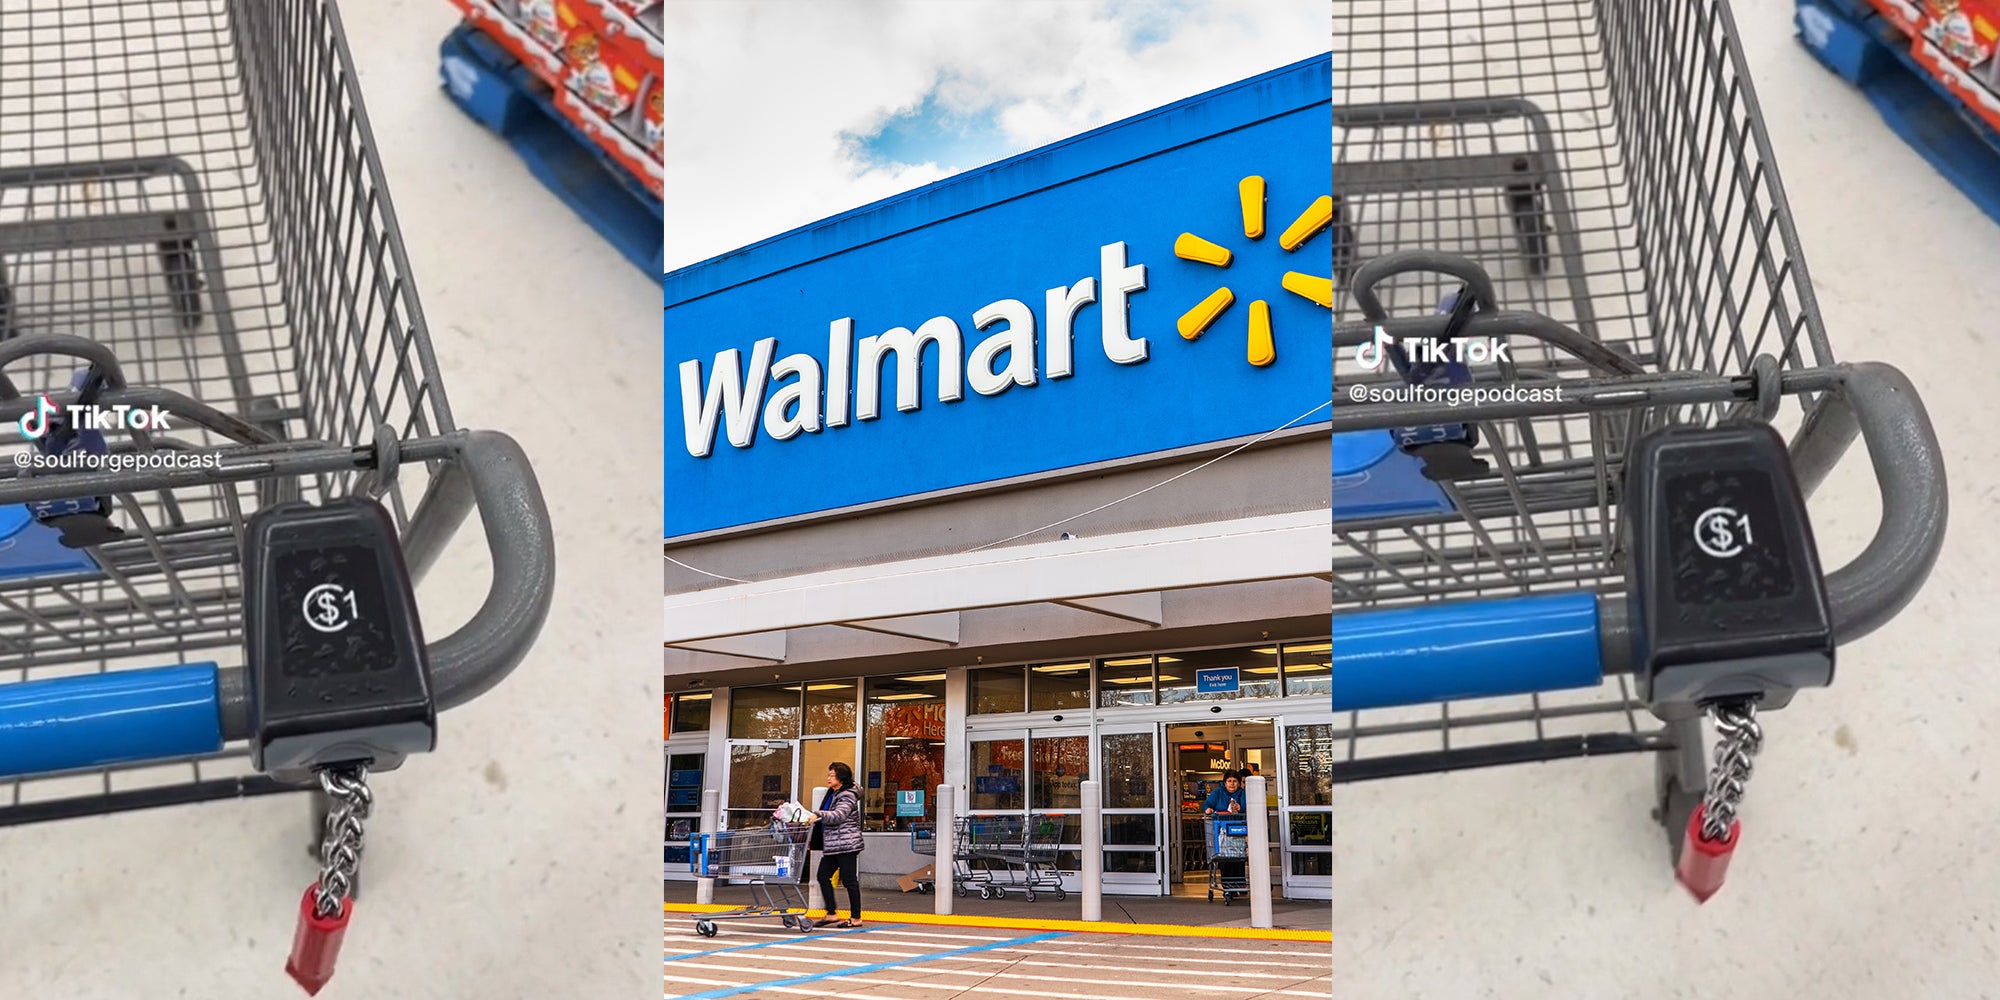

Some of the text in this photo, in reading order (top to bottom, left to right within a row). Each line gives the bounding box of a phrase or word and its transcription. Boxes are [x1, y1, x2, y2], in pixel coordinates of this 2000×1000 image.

[679, 240, 1148, 458] Walmart
[1203, 674, 1233, 682] Thank you
